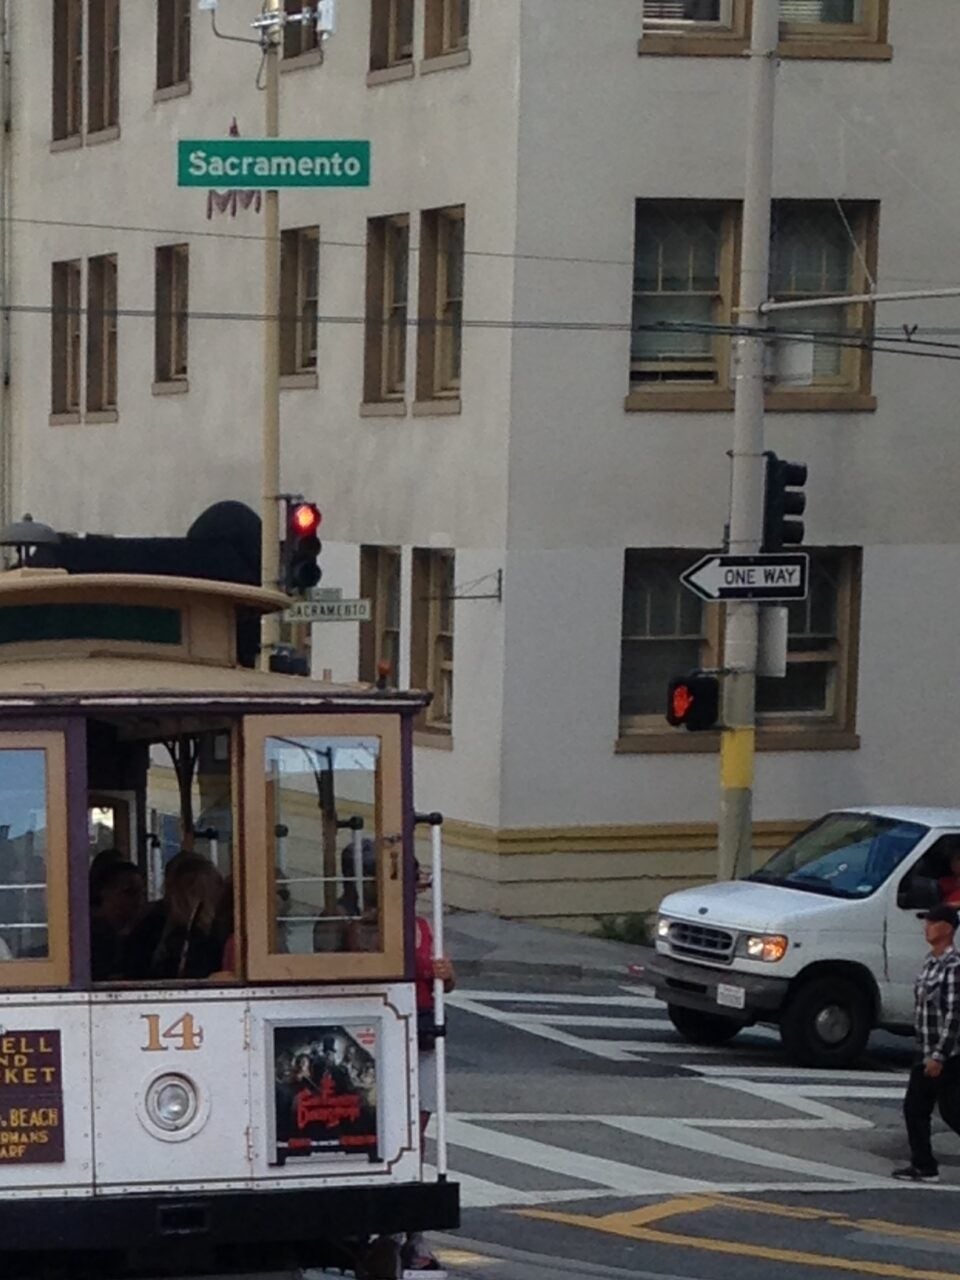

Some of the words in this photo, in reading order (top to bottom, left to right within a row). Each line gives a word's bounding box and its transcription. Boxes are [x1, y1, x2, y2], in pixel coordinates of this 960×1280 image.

[189, 150, 361, 176] Sacramento
[724, 569, 756, 585] ONE
[763, 568, 797, 584] WAY
[140, 1012, 204, 1051] 14
[9, 1108, 59, 1127] BEACH
